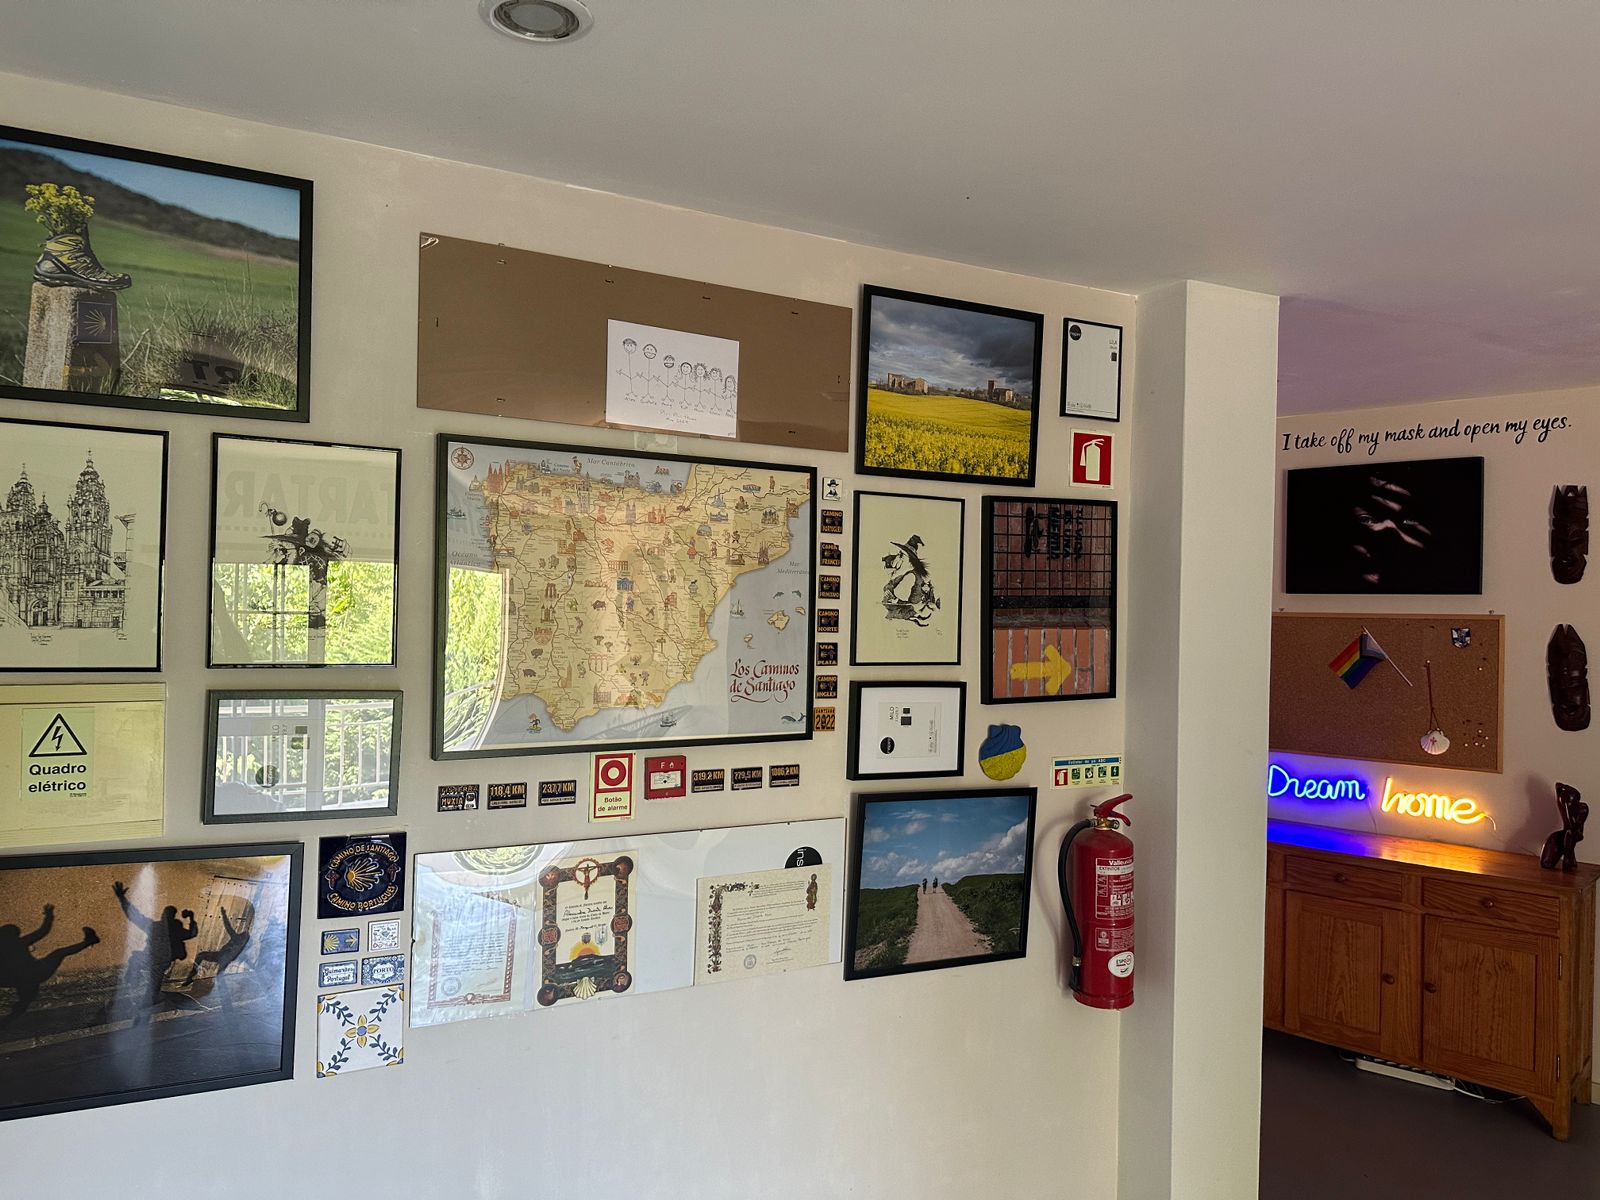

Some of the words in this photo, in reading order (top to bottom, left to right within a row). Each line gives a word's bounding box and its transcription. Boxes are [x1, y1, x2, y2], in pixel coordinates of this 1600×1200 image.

[1282, 433, 1291, 450] I
[1294, 432, 1326, 449] take
[1330, 428, 1354, 453] off
[1358, 431, 1379, 455] my
[1384, 423, 1425, 441] mask
[1428, 418, 1460, 438] and
[1463, 422, 1500, 443] open
[1505, 419, 1527, 444] my
[1533, 416, 1572, 443] eyes.
[730, 658, 750, 678] Los
[753, 660, 799, 678] Caminos
[729, 679, 742, 693] de
[744, 677, 796, 703] Santiago
[29, 763, 87, 776] Quadro
[713, 770, 724, 780] KM
[751, 769, 762, 778] KM
[789, 766, 799, 775] KM
[28, 780, 86, 793] elétrico
[511, 784, 525, 794] KM
[562, 782, 575, 792] KM
[1267, 765, 1366, 801] Dream
[1381, 777, 1486, 824] home
[597, 804, 606, 812] de
[607, 804, 628, 812] alarme
[329, 848, 355, 868] CAMINO
[355, 844, 365, 852] DE
[366, 844, 398, 862] SANTIAGO
[329, 892, 356, 909] CAMINO
